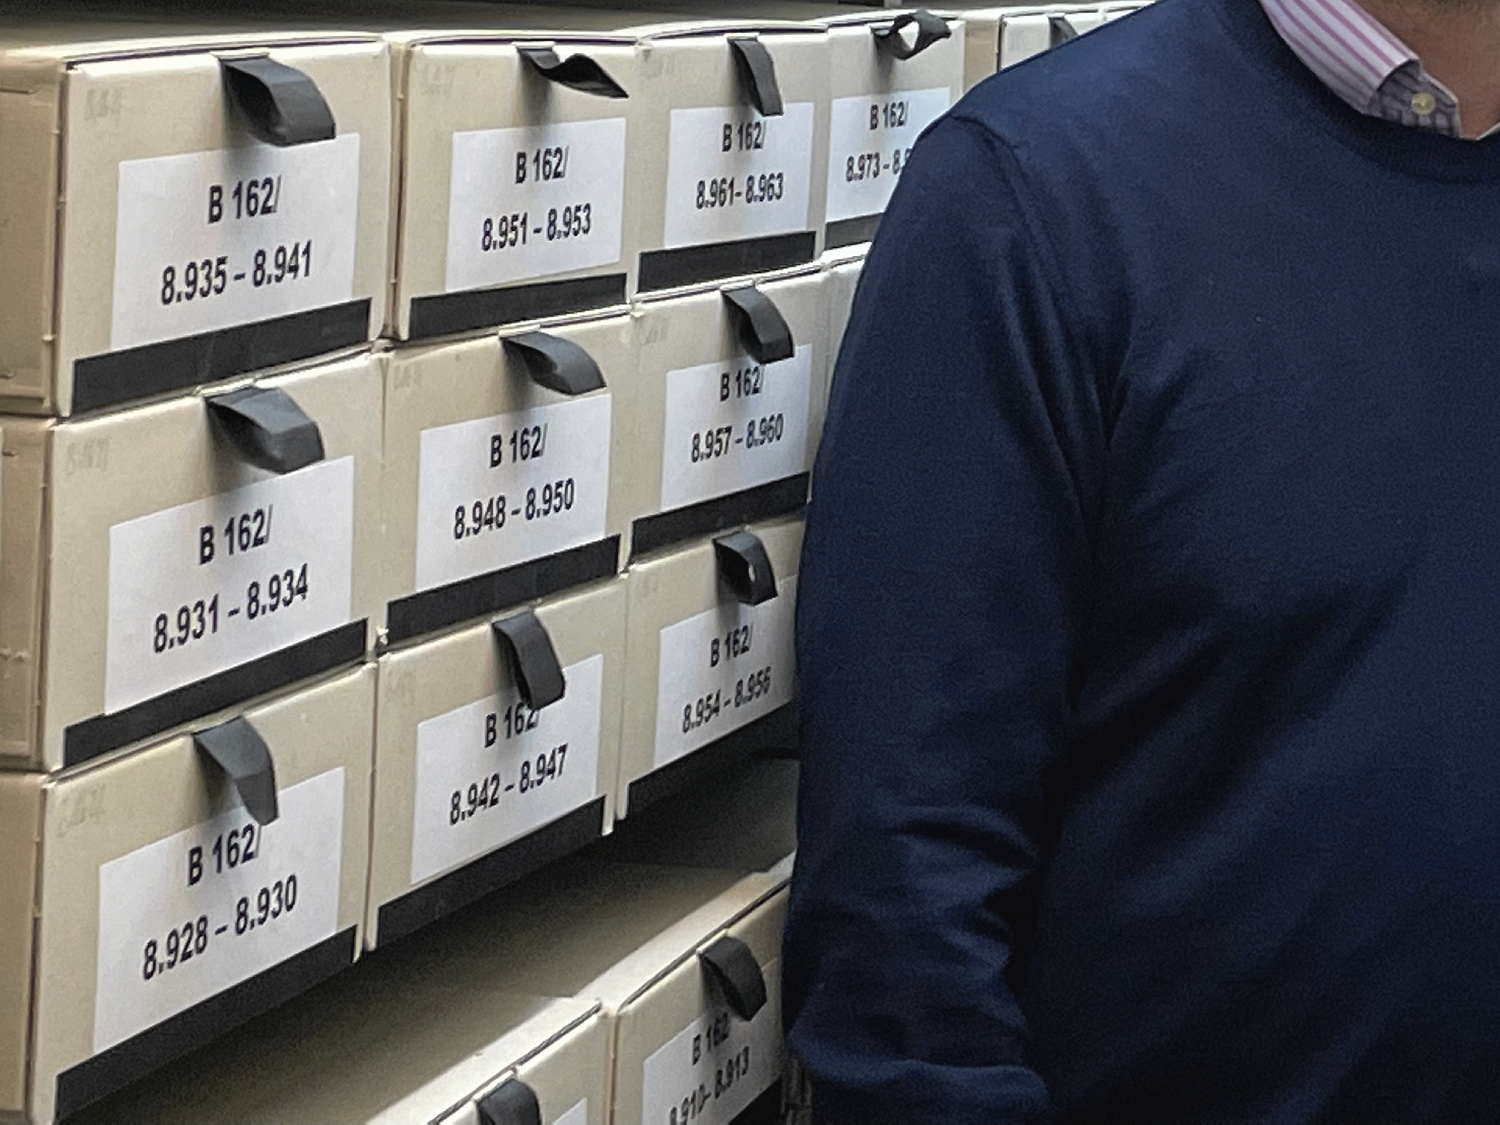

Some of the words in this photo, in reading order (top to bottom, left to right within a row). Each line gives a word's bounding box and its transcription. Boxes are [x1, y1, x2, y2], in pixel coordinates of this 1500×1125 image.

[722, 123, 732, 152] B
[738, 118, 767, 151] 162/
[870, 105, 879, 130] B
[515, 152, 527, 184] B
[533, 144, 569, 181] 162/
[846, 152, 880, 182] 8.973
[208, 185, 223, 224] B
[232, 174, 281, 219] 162/
[746, 172, 783, 204] 8.963
[482, 212, 528, 251] 8.951
[547, 203, 591, 241] 8.953
[161, 256, 228, 305] 8.935
[252, 240, 312, 287] 8.941
[720, 373, 730, 402] B
[735, 362, 766, 398] 162/
[490, 434, 502, 468] B
[510, 422, 548, 463] 162/
[691, 426, 732, 463] 8.957
[746, 413, 784, 449] 8.960
[454, 495, 506, 540] 8.948
[525, 478, 574, 520] 8.950
[199, 525, 214, 565] B
[224, 503, 273, 555] 162/
[154, 593, 218, 653] 8.931
[247, 563, 308, 620] 8.934
[710, 638, 720, 667] B
[725, 621, 755, 661] 162/
[484, 713, 497, 748] B
[682, 689, 721, 734] 8.954
[450, 773, 500, 826] 8.942
[519, 743, 568, 793] 8.947
[187, 846, 203, 887] B
[212, 822, 263, 873] 162/
[143, 915, 208, 980] 8.928
[235, 874, 297, 936] 8.930
[692, 1034, 702, 1066] B
